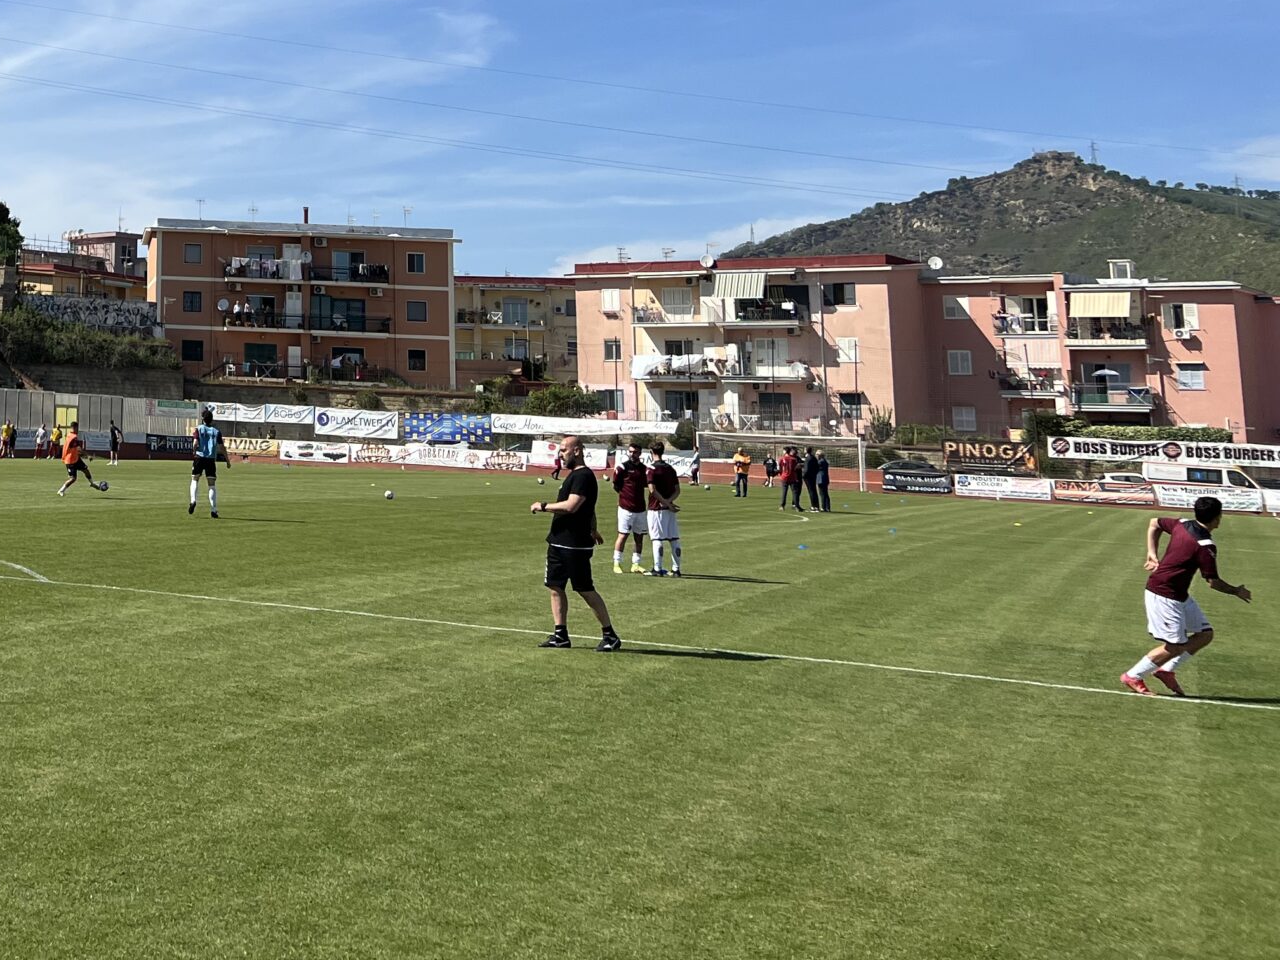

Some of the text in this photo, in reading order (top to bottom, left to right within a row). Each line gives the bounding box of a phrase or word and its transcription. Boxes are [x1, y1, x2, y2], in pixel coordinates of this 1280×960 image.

[492, 416, 516, 431] Capo
[228, 438, 272, 452] IVING
[1074, 441, 1160, 457] BOSS BURGER
[1186, 446, 1275, 462] BOSS BURGER
[1181, 487, 1220, 495] Magazine
